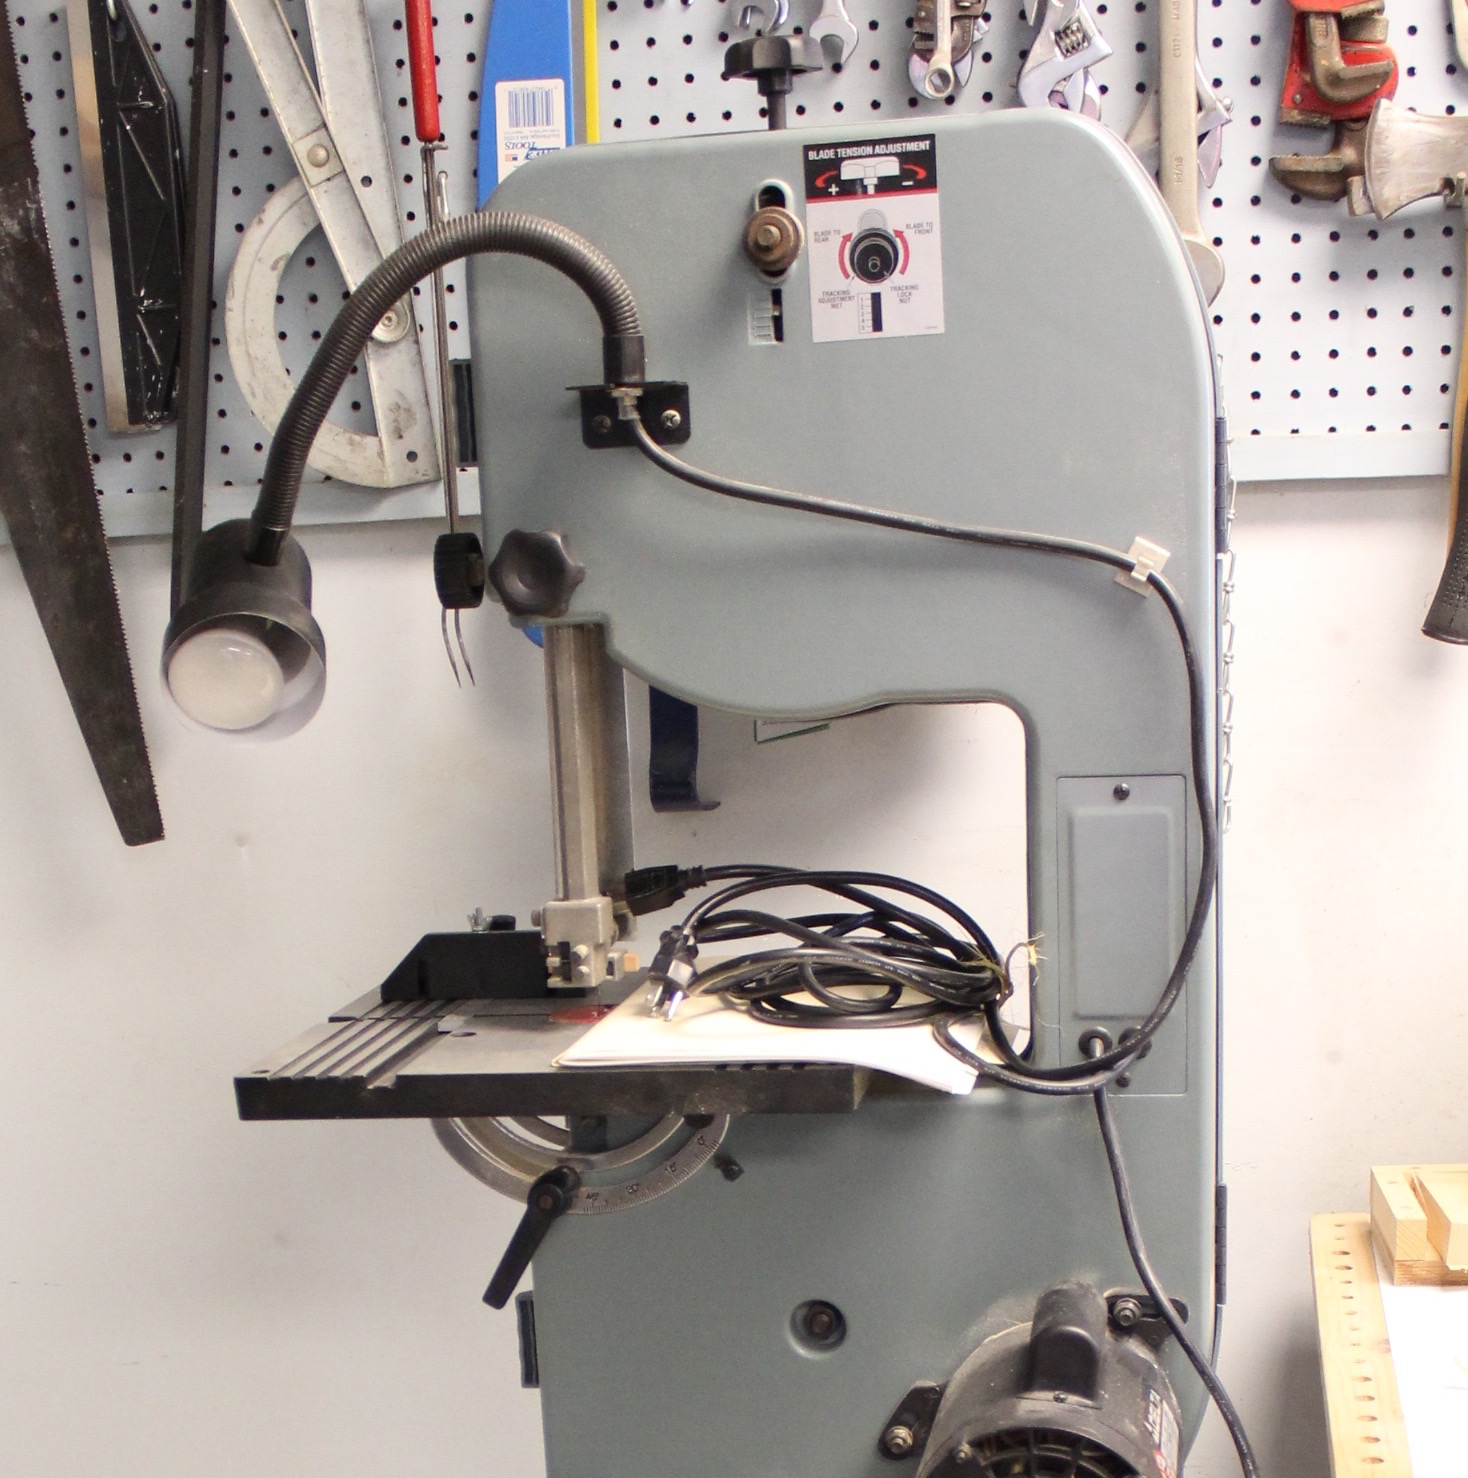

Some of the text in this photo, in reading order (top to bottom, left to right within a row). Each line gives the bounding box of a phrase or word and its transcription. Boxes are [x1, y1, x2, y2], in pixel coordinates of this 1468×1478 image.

[504, 141, 537, 150] TOOLS
[808, 140, 931, 160] BLADE TENSION ADJUSTMENT
[890, 284, 919, 292] TRACKING
[817, 295, 855, 304] ADJUSTMENT
